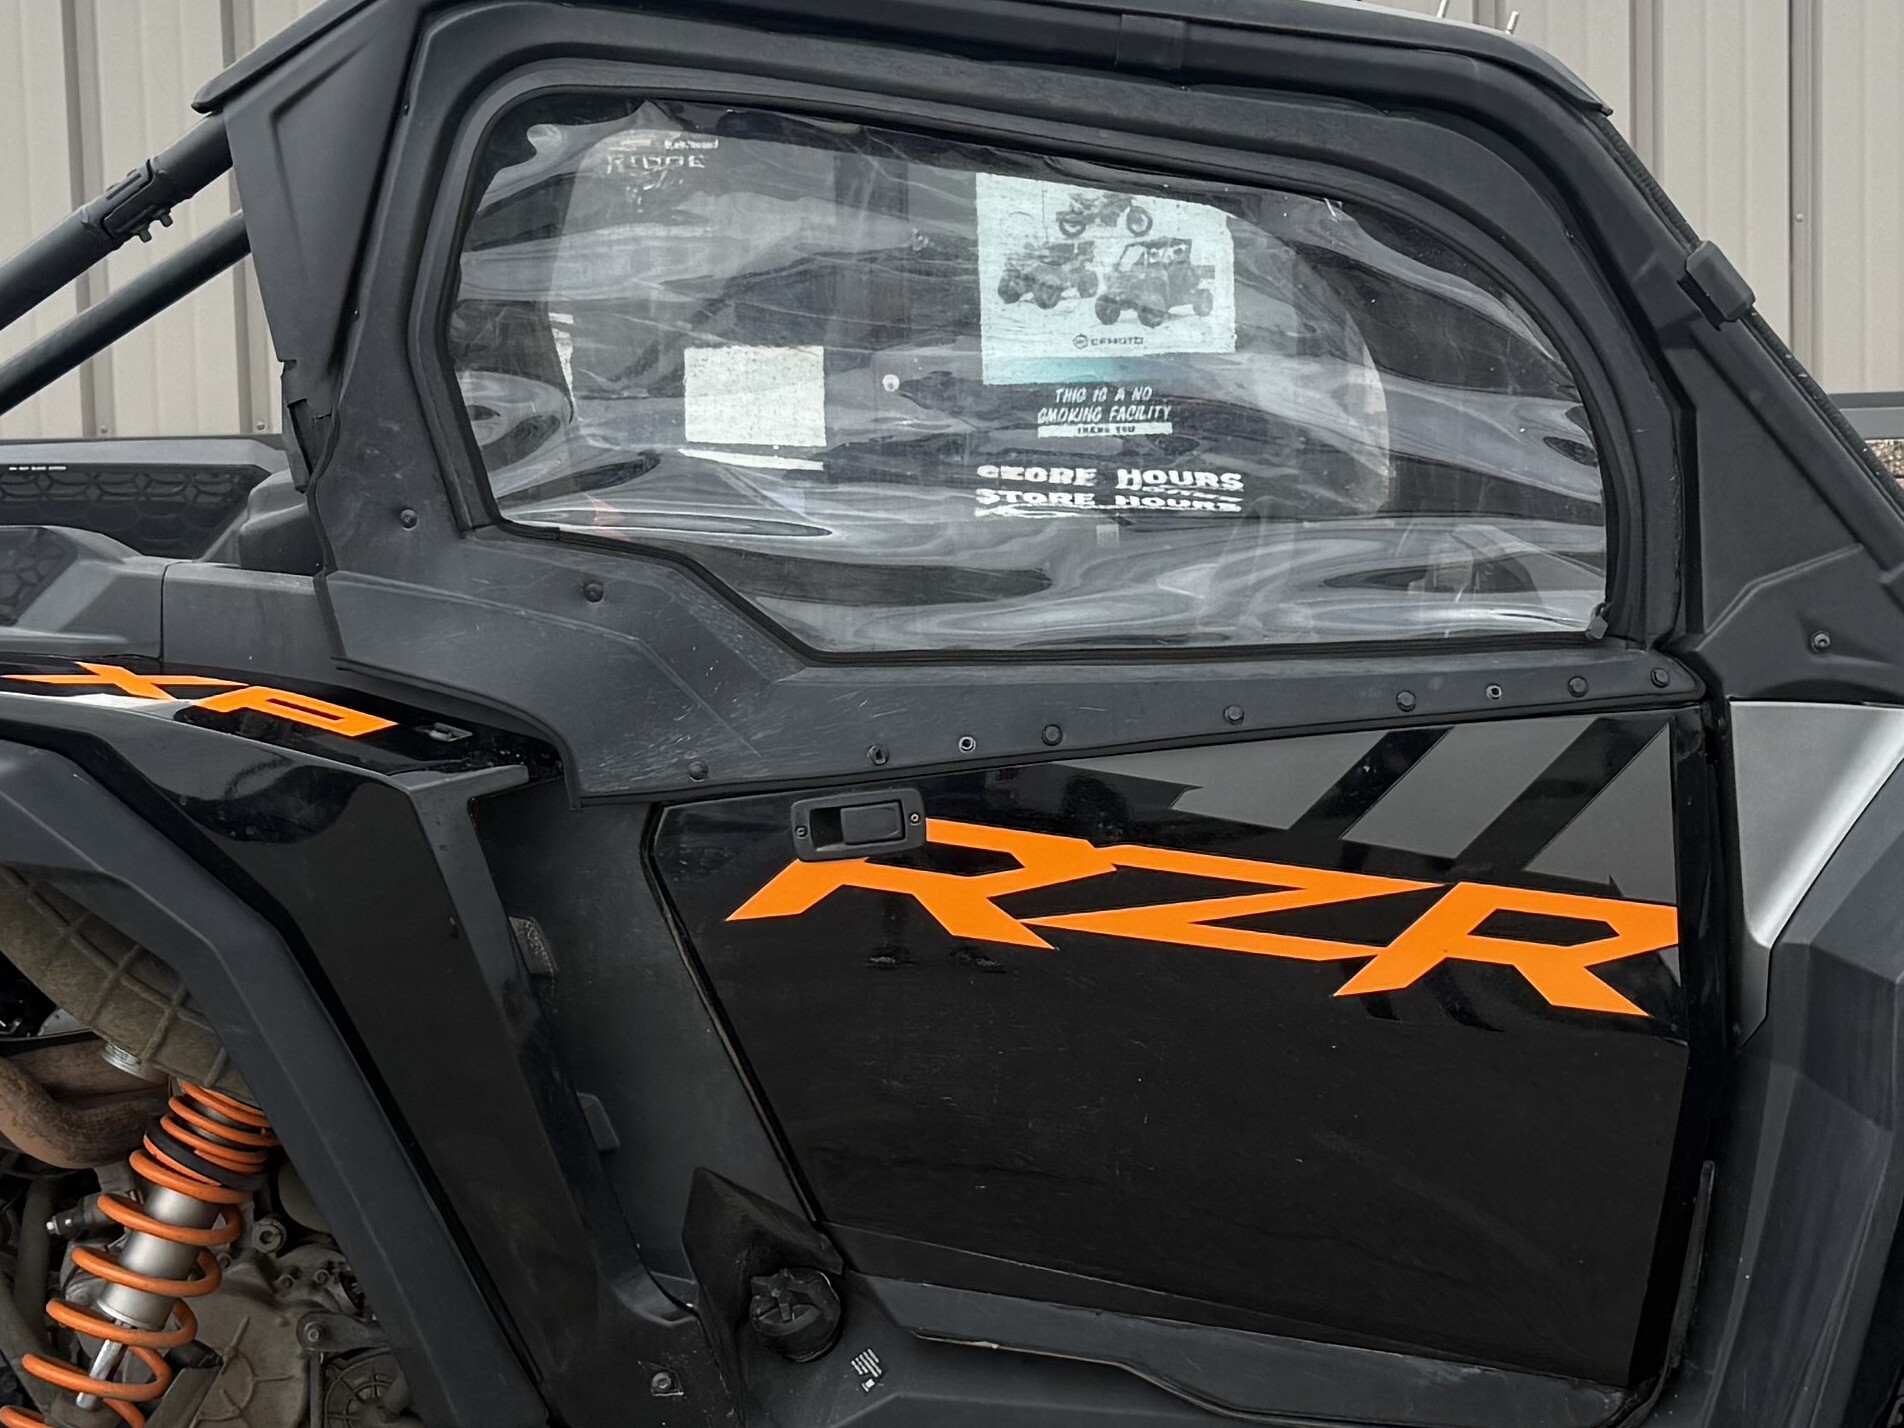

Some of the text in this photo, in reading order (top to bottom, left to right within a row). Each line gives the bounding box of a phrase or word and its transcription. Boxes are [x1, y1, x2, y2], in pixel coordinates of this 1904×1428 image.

[1114, 387, 1125, 401] A
[1132, 385, 1153, 401] NO
[1109, 404, 1173, 422] FACILITY
[1115, 468, 1245, 492] HOURS
[1, 661, 399, 738] XP
[726, 818, 1679, 1017] RZR
